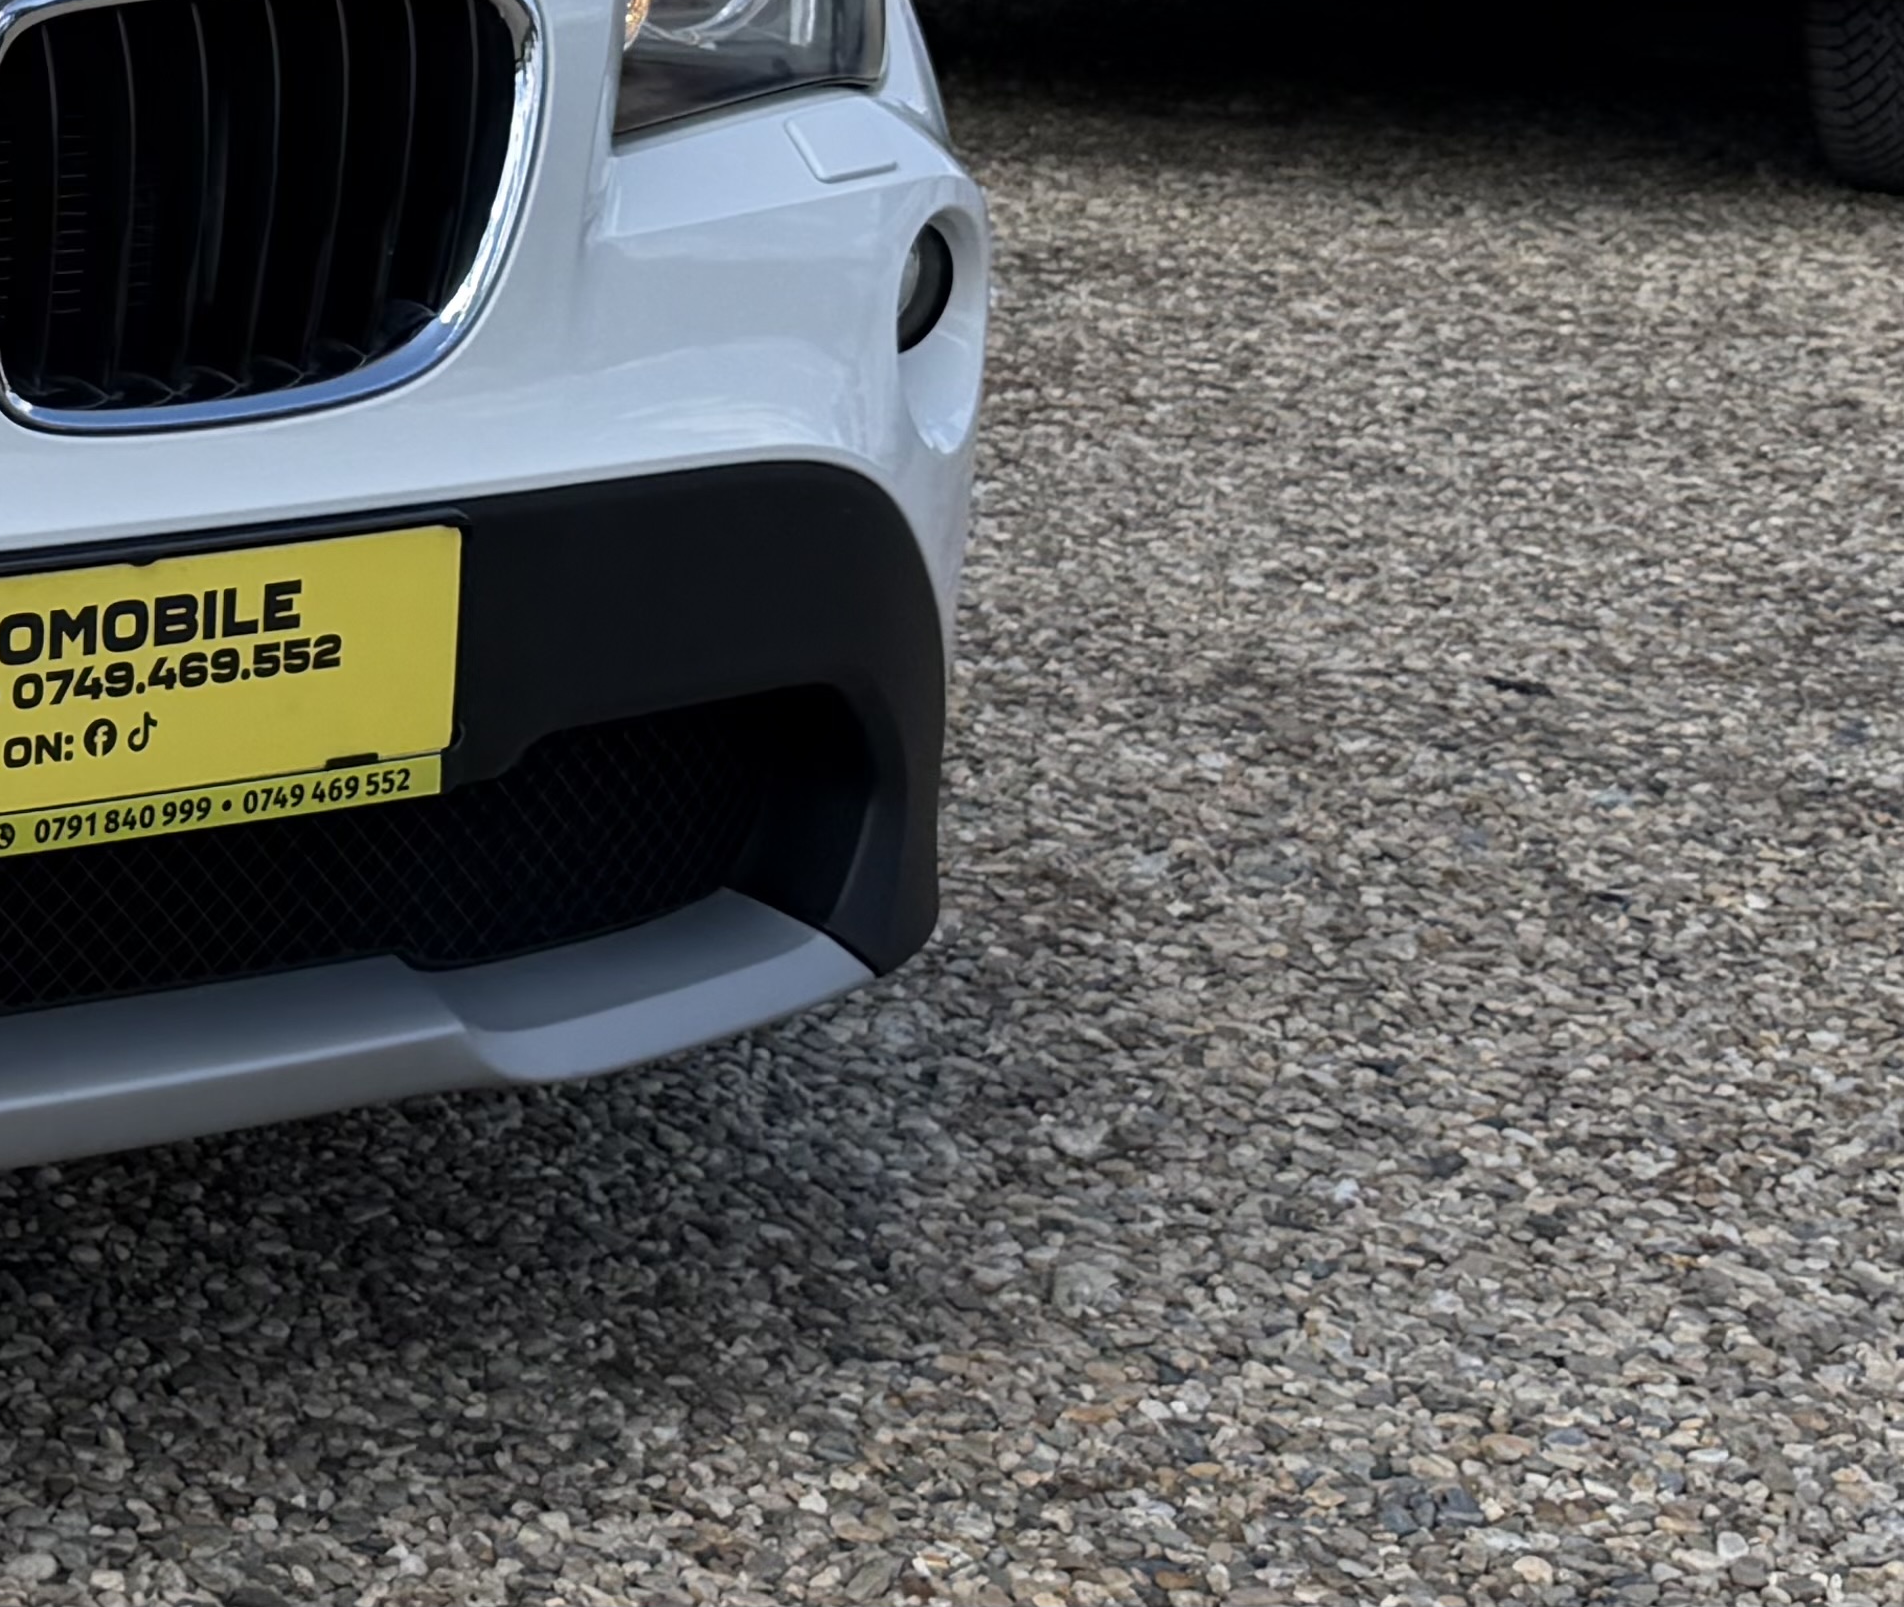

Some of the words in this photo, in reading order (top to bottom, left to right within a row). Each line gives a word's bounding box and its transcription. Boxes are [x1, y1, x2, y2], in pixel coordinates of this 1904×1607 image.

[12, 634, 342, 709] 0749.469.552
[3, 731, 74, 768] ON:
[34, 812, 97, 844] 0791
[103, 805, 155, 834] 840
[162, 796, 212, 826] 999
[242, 783, 305, 814] 0749
[311, 775, 359, 804] 469
[365, 768, 411, 795] 552
